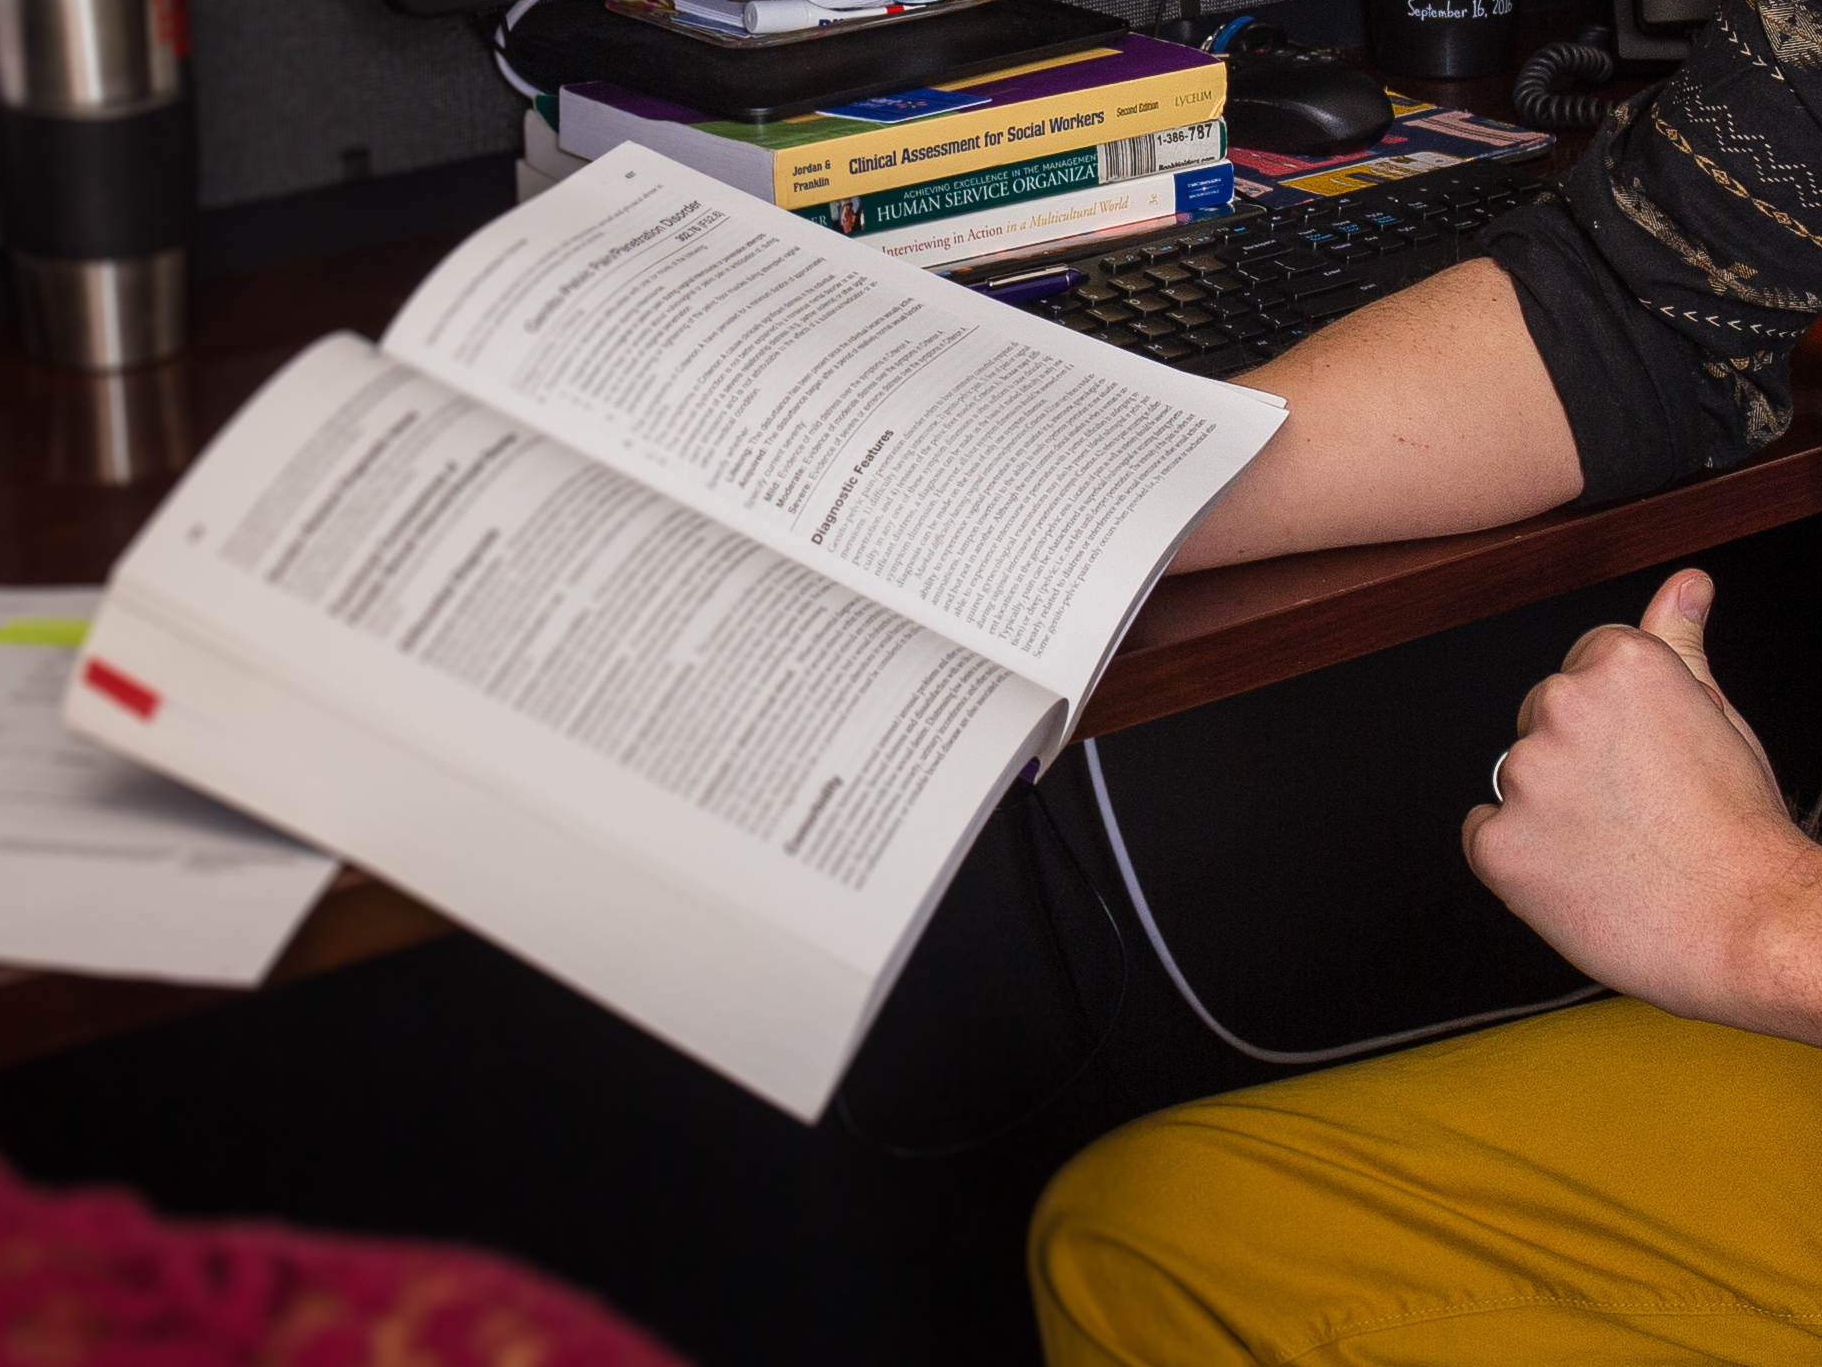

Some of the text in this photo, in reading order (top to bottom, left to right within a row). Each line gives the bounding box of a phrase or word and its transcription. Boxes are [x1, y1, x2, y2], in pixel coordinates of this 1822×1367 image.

[1472, 0, 1491, 22] 16,
[1116, 100, 1159, 118] Second Edition
[1157, 123, 1212, 146] 1-386-787
[792, 160, 831, 176] Jordan &
[849, 109, 1105, 176] Clinical Assessment for Social Workers
[793, 176, 830, 192] Franklin
[878, 163, 1099, 223] HUMAN SERVICE ORGANIZA
[903, 182, 951, 199] ACHIEVING
[954, 173, 1008, 190] EXCELLENCE
[1011, 168, 1019, 177] IN
[1023, 164, 1041, 175] THE
[660, 199, 703, 229] Disorder
[881, 197, 1128, 259] Interviewing in Action in a Multicultural World
[764, 479, 781, 502] Mild:
[778, 443, 804, 478] Evidence
[807, 420, 822, 435] mild
[819, 398, 842, 421] distress
[776, 464, 806, 508] Moderate:
[802, 431, 830, 464] Evidence
[833, 398, 860, 424] moderate
[788, 479, 812, 514] Severe:
[808, 445, 836, 480] Evidence
[840, 417, 859, 435] severe
[811, 428, 895, 547] Diagnostic Features
[1020, 618, 1046, 653] linearly
[1038, 588, 1061, 618] related
[1060, 549, 1086, 578] distress
[1032, 545, 1104, 659] Some genito-pelvic pain only
